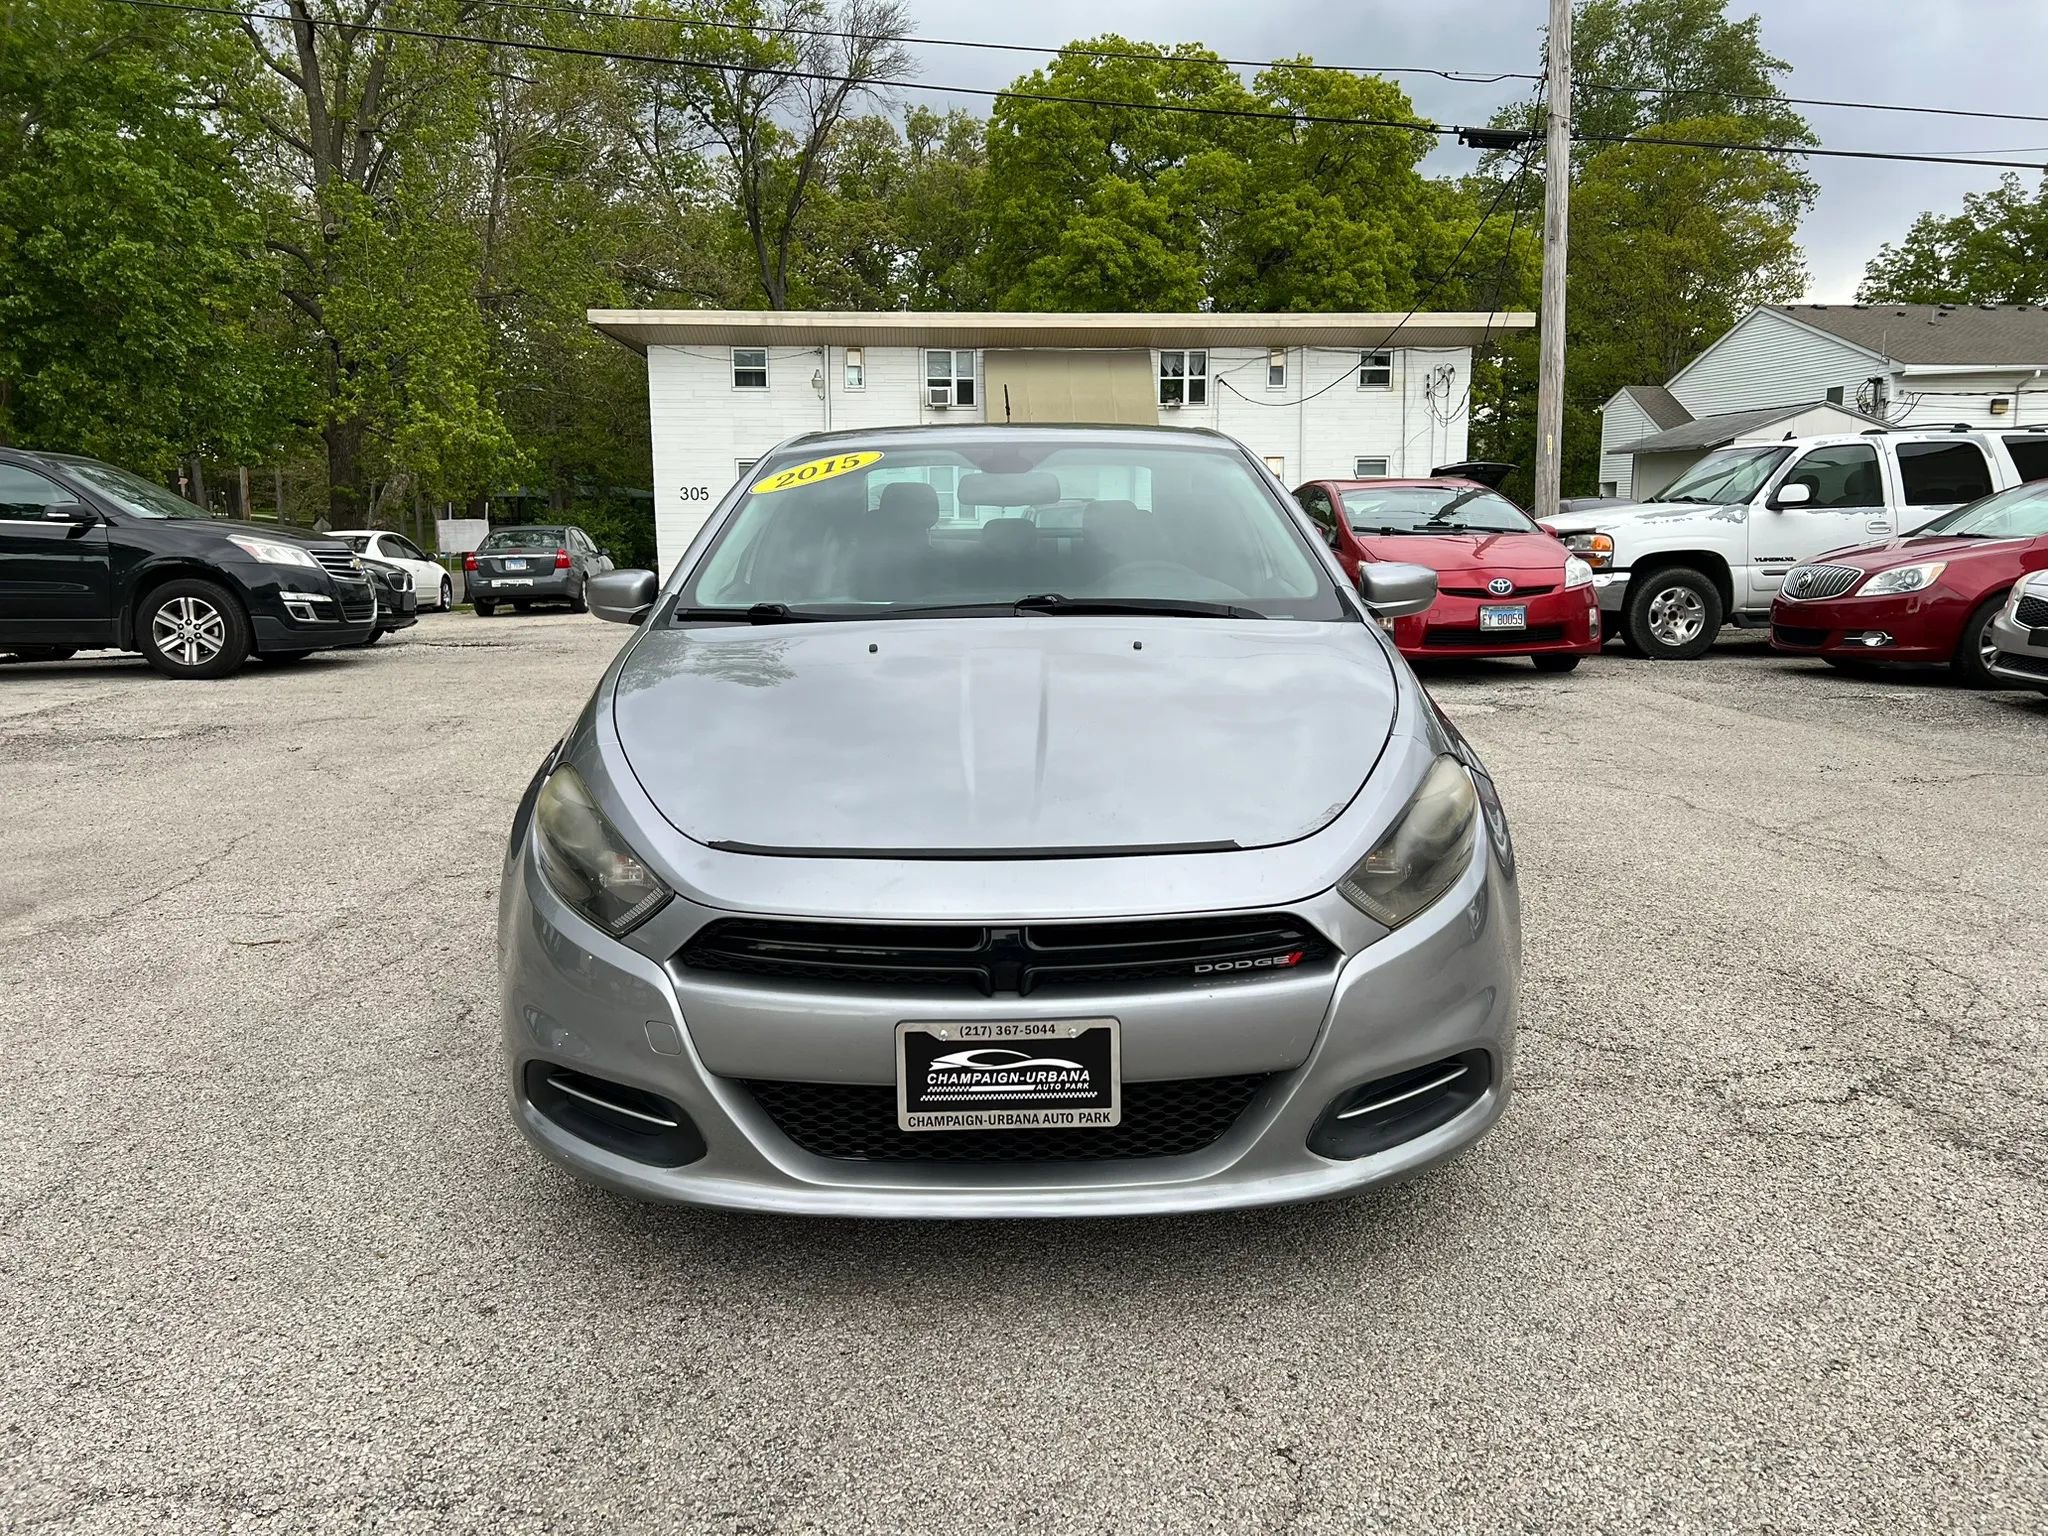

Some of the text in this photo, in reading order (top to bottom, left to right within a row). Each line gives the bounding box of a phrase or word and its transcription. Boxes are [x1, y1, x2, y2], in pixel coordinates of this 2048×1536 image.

[775, 455, 860, 488] 2015
[680, 487, 709, 501] 305
[1497, 613, 1523, 625] 80059
[1194, 955, 1290, 973] DODGE
[959, 1024, 1056, 1038] (217) 367-5044
[926, 1070, 1090, 1085] CHAMPAIGN-URBANA
[1036, 1082, 1089, 1091] AUTO PARK
[907, 1112, 1111, 1128] CHAMPAIGN-URBANA AUTO PARK
